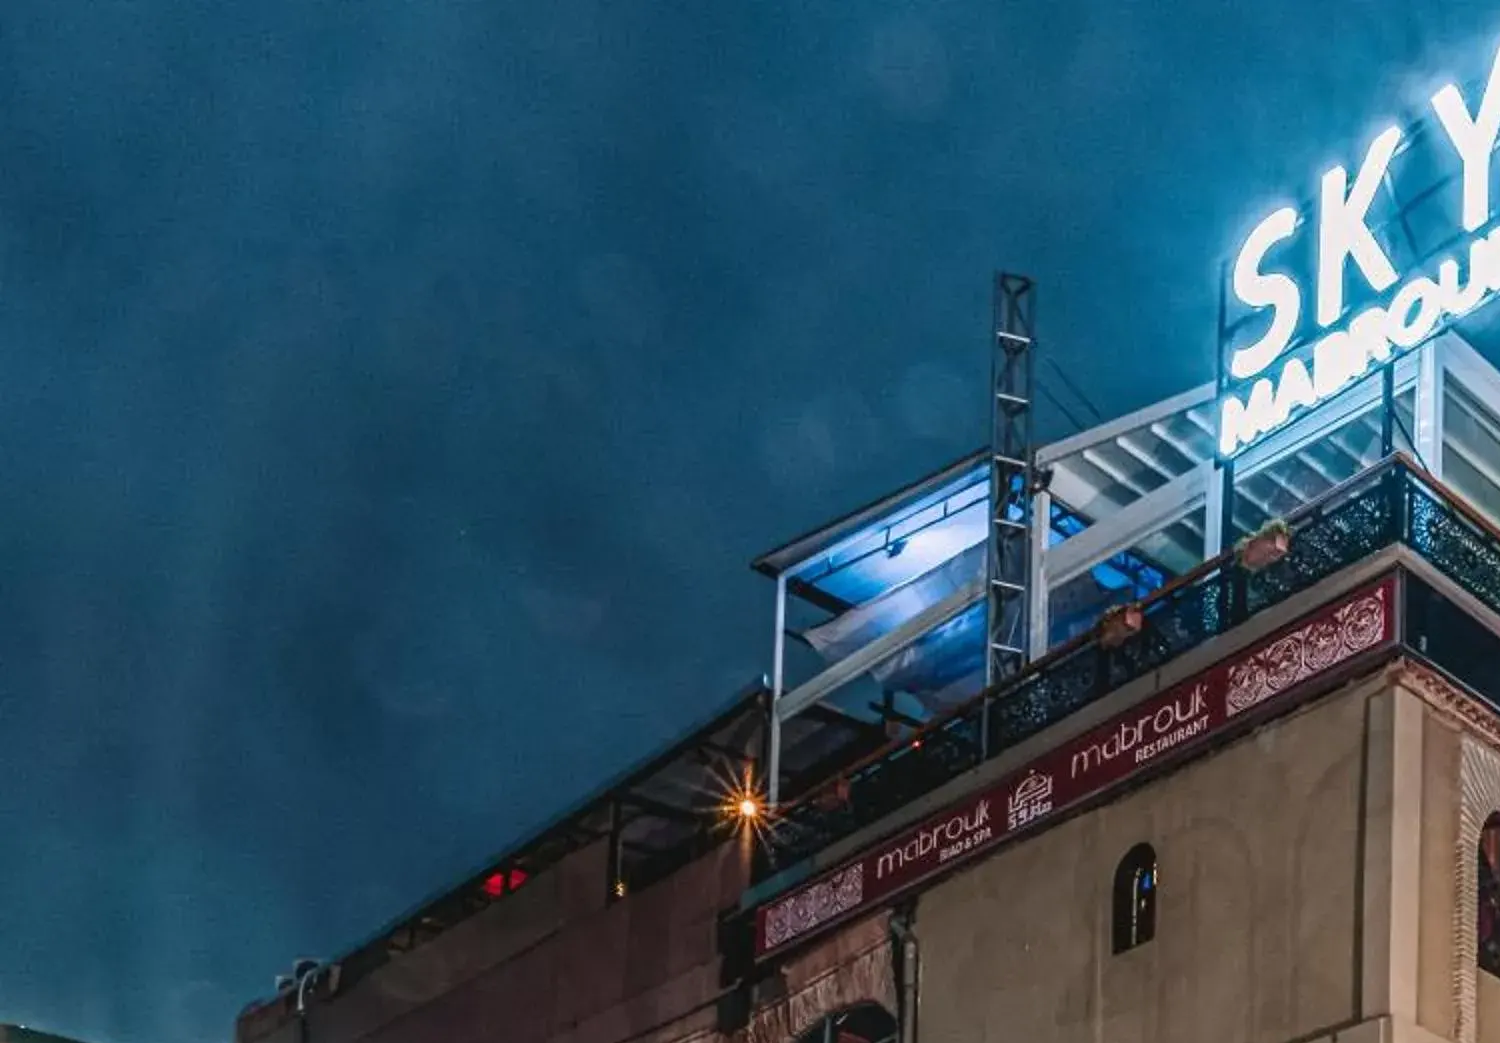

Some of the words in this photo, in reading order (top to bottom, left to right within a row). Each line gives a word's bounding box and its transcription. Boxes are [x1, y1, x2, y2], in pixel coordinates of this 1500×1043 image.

[1071, 683, 1208, 779] mabrouk
[1135, 714, 1210, 763] RESTAURANT
[877, 799, 990, 880] mabrouk
